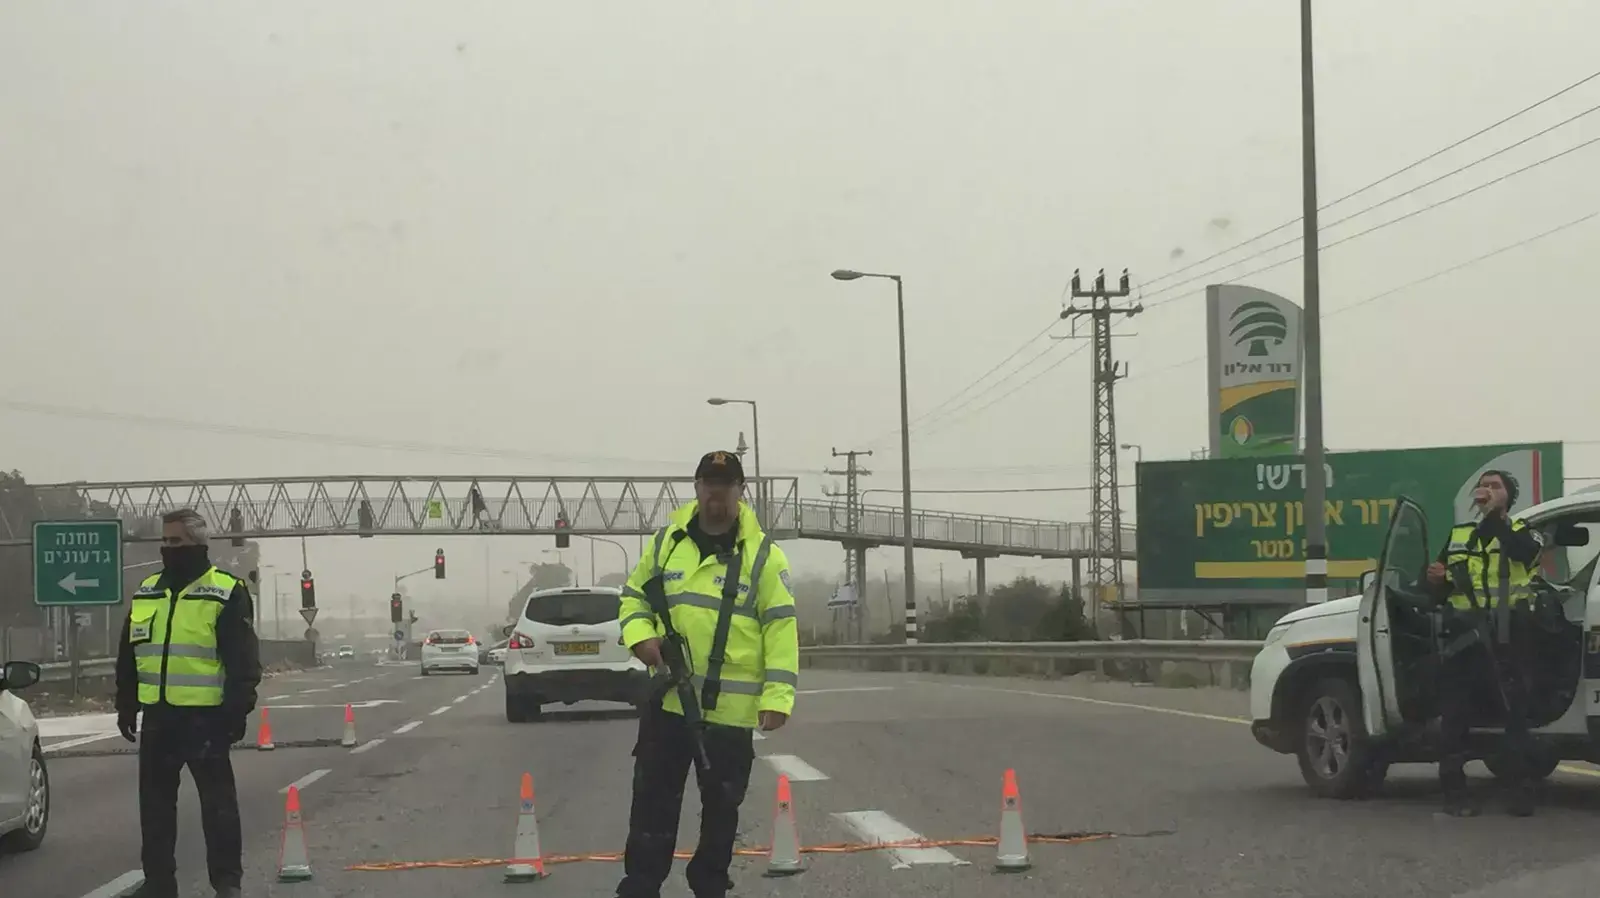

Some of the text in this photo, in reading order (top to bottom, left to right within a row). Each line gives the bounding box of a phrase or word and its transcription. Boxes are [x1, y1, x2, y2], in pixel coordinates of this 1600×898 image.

[1224, 361, 1292, 376] דור אלון
[1194, 502, 1278, 537] צריפין
[1284, 500, 1344, 536] און
[55, 531, 100, 545] מחנה
[43, 550, 112, 564] גדעונים
[1250, 539, 1294, 558] מטר
